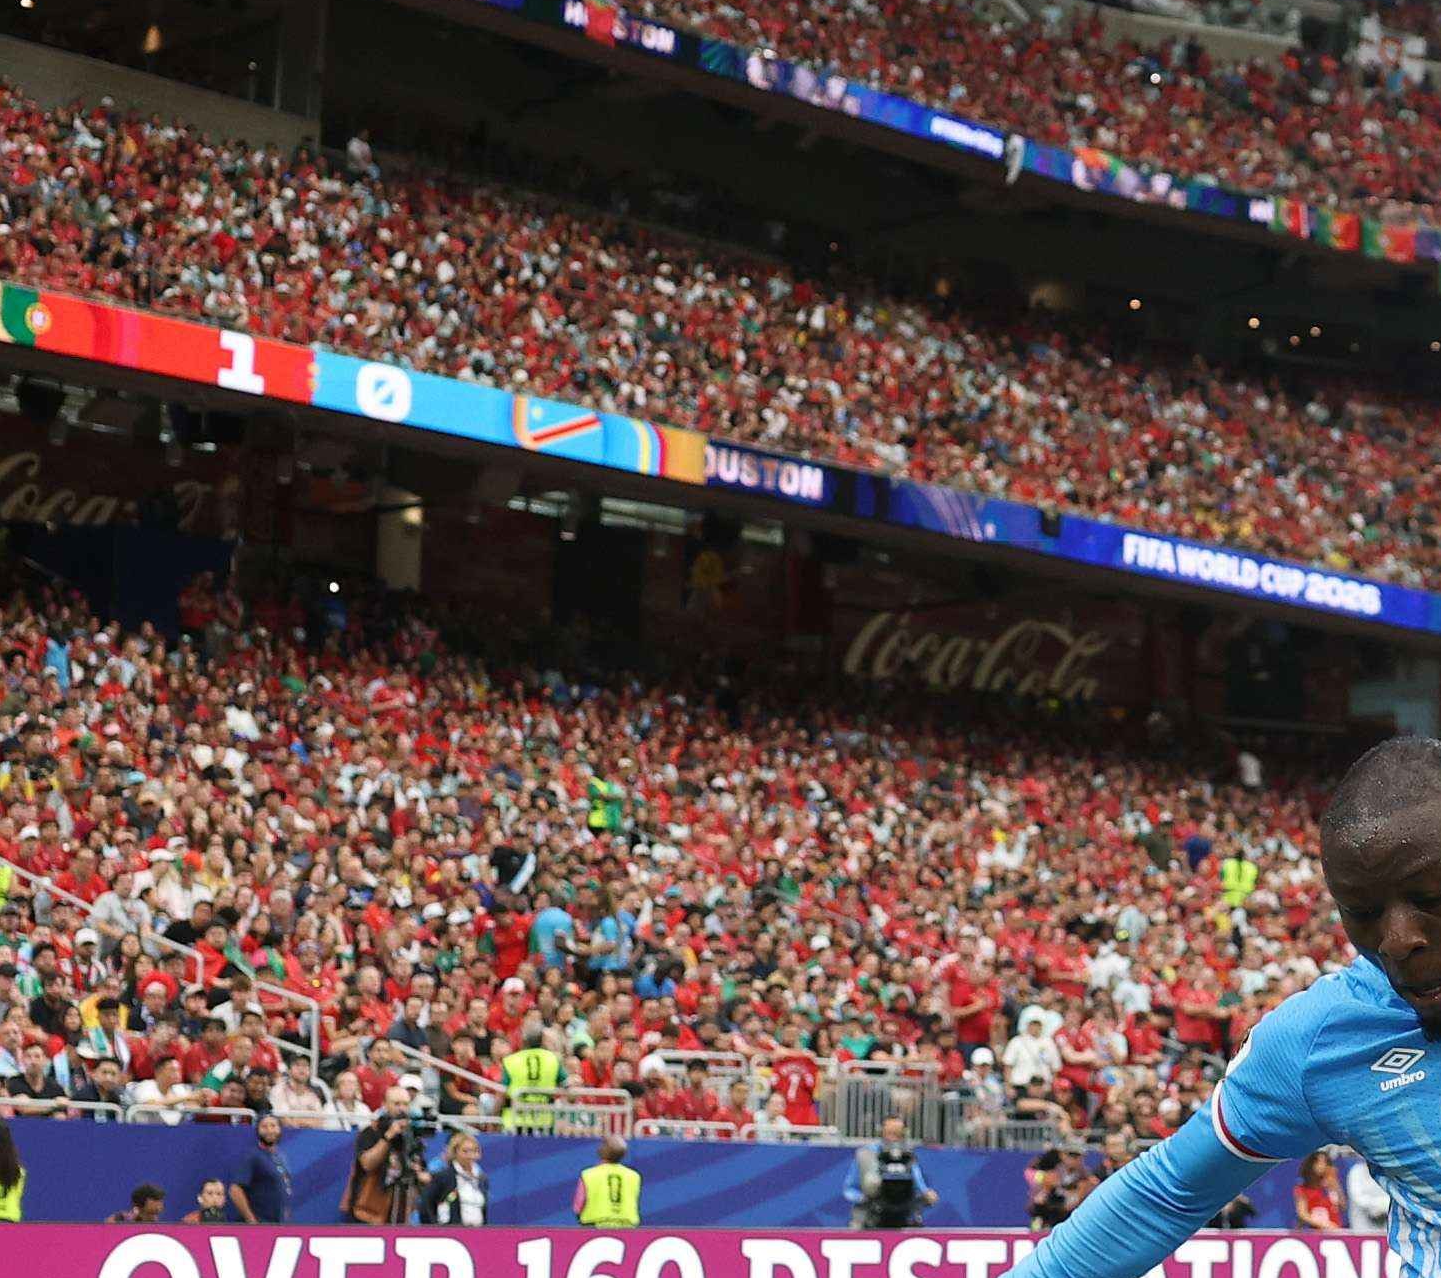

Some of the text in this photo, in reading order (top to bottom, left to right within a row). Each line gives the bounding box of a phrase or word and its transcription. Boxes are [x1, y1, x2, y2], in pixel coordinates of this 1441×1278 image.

[218, 330, 265, 395] 1
[1122, 532, 1382, 616] FIFA WORLD CUP 2026
[1380, 1069, 1426, 1092] umbro
